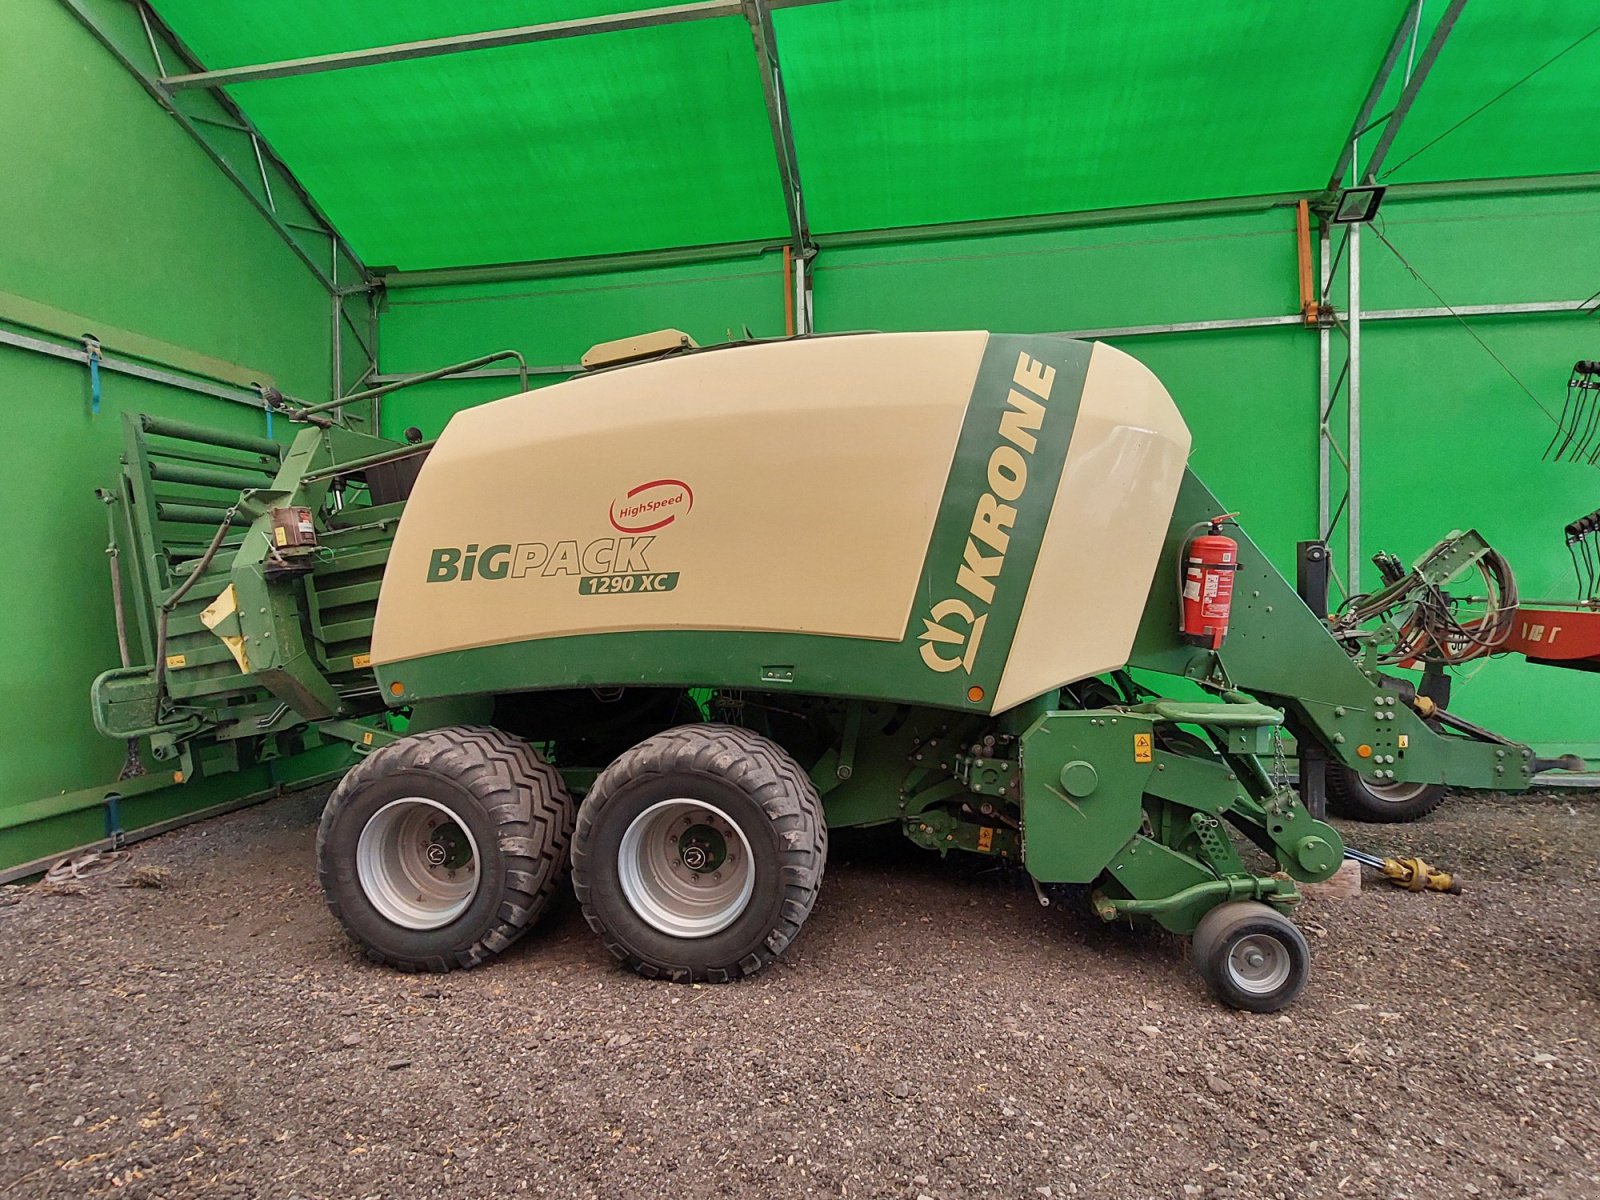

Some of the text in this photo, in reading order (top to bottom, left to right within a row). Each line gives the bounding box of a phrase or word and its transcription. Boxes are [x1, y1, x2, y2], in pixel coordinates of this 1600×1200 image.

[956, 351, 1056, 605] KRONE
[619, 493, 683, 518] HighSpeed
[588, 574, 668, 593] 1290 XC
